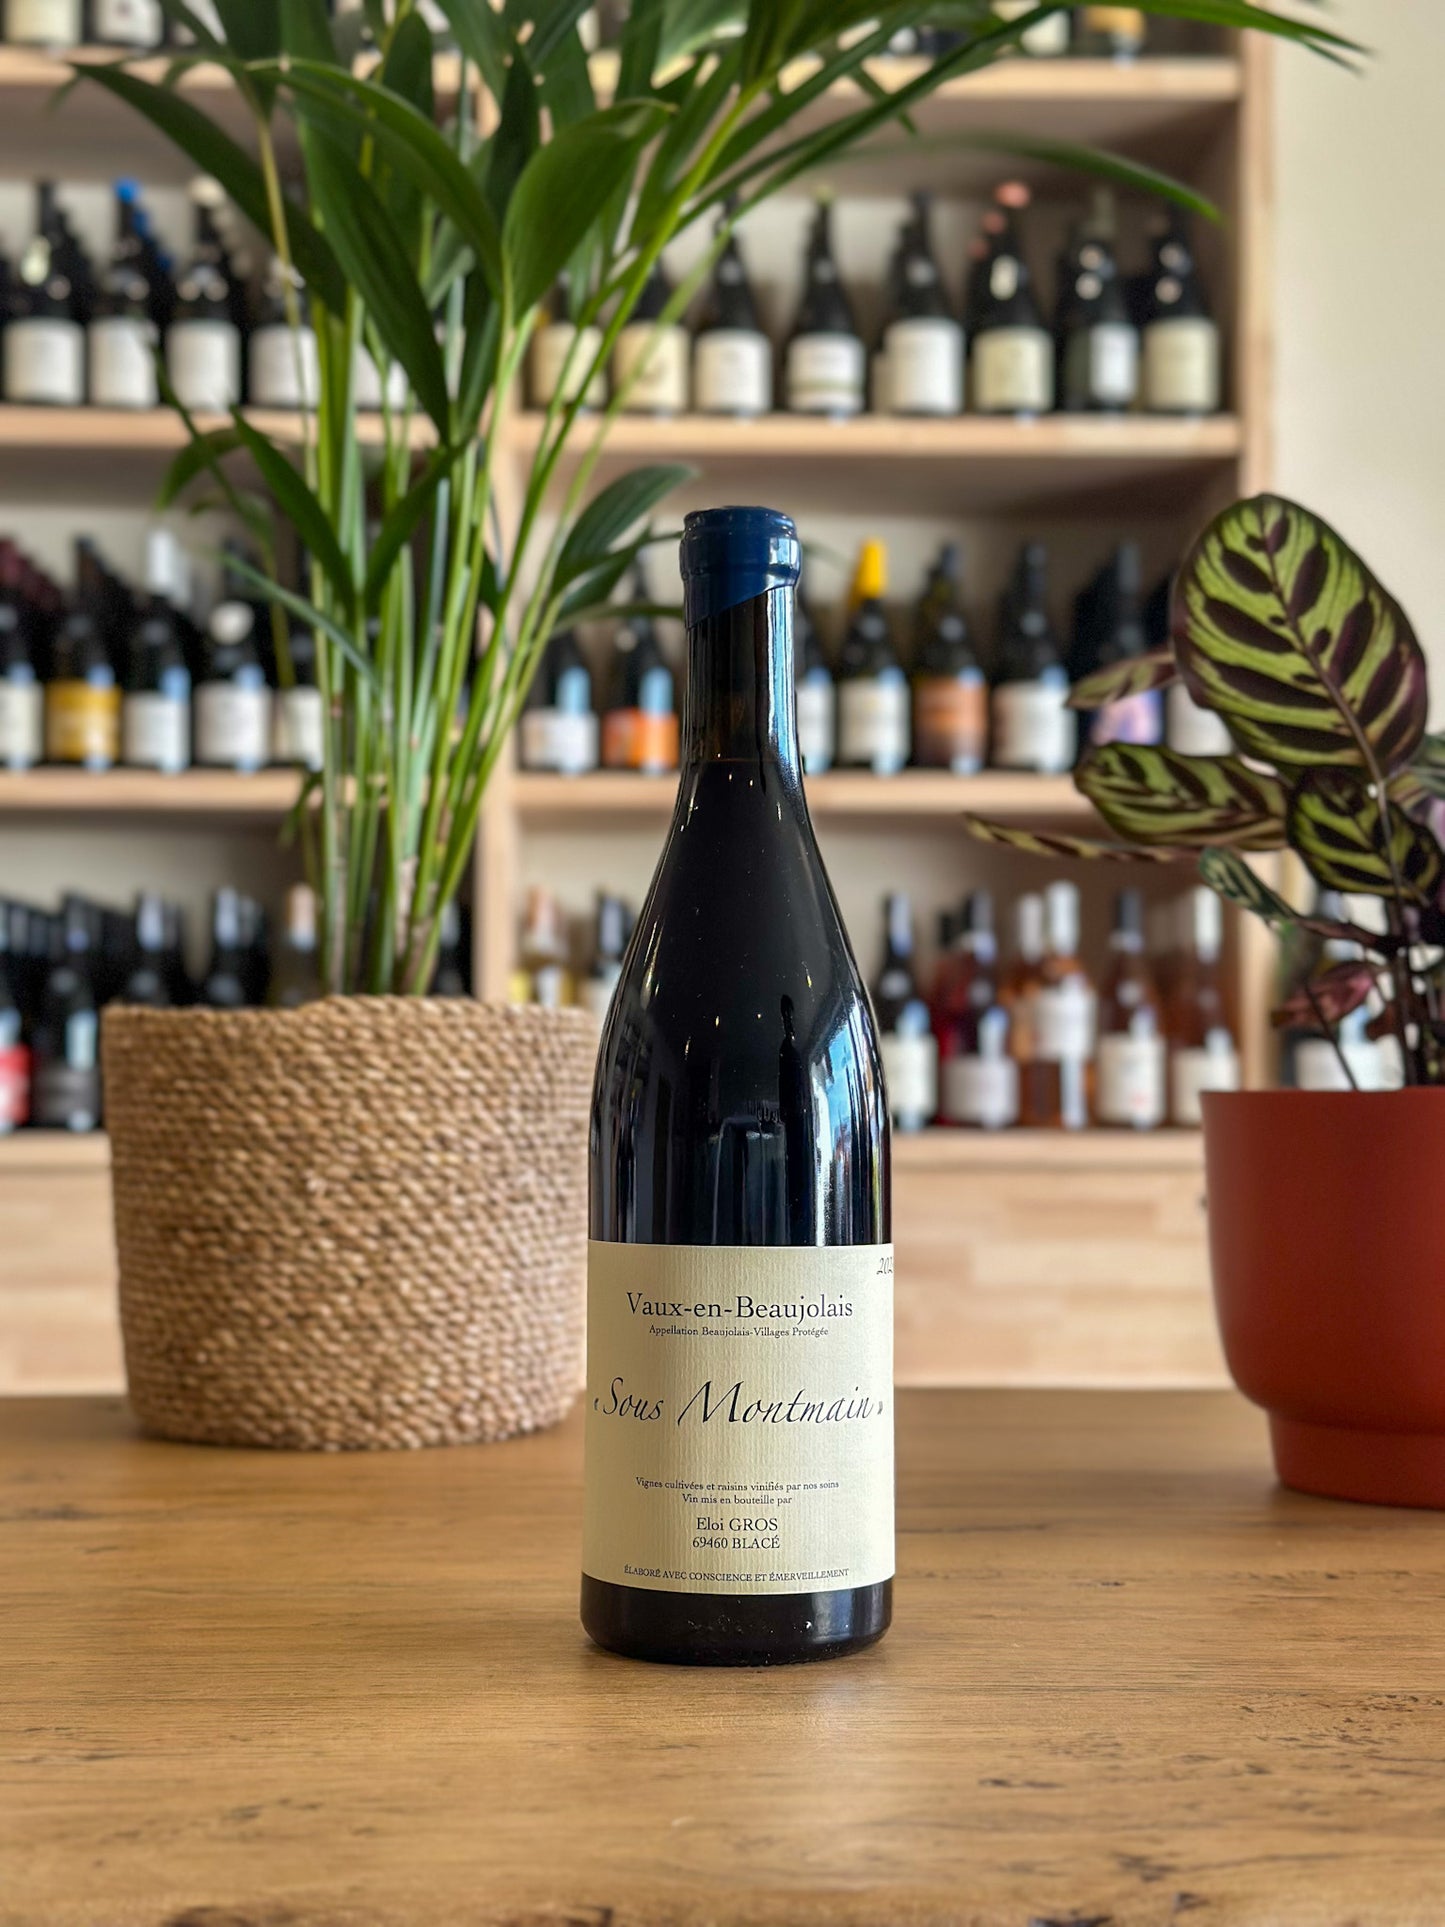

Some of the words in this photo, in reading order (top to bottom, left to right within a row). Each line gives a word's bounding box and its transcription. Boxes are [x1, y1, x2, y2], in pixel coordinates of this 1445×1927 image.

[626, 1291, 853, 1325] Vaux-en-Beaujolais
[649, 1325, 698, 1337] Appellation
[702, 1327, 790, 1338] Beaujolais-Villages
[792, 1327, 829, 1338] Protégée
[636, 1476, 663, 1490] Vignes
[664, 1480, 704, 1491] cultivées
[717, 1482, 748, 1491] raisins
[750, 1482, 784, 1491] vinifiés
[786, 1485, 801, 1493] par
[819, 1480, 839, 1489] soins
[682, 1493, 699, 1503] Vin
[701, 1494, 718, 1504] mis
[734, 1495, 775, 1505] bouteille
[777, 1497, 793, 1506] par
[696, 1516, 724, 1531] Eloi
[729, 1517, 778, 1532] GROS
[692, 1536, 728, 1549] 69460
[732, 1534, 780, 1549] BLACÉ
[624, 1564, 661, 1578] ÉLABORÉ
[662, 1570, 687, 1580] AVEC
[689, 1571, 752, 1582] CONSCIENCE
[754, 1573, 767, 1582] ET
[769, 1568, 849, 1582] ÉMERVEILLEMENT
